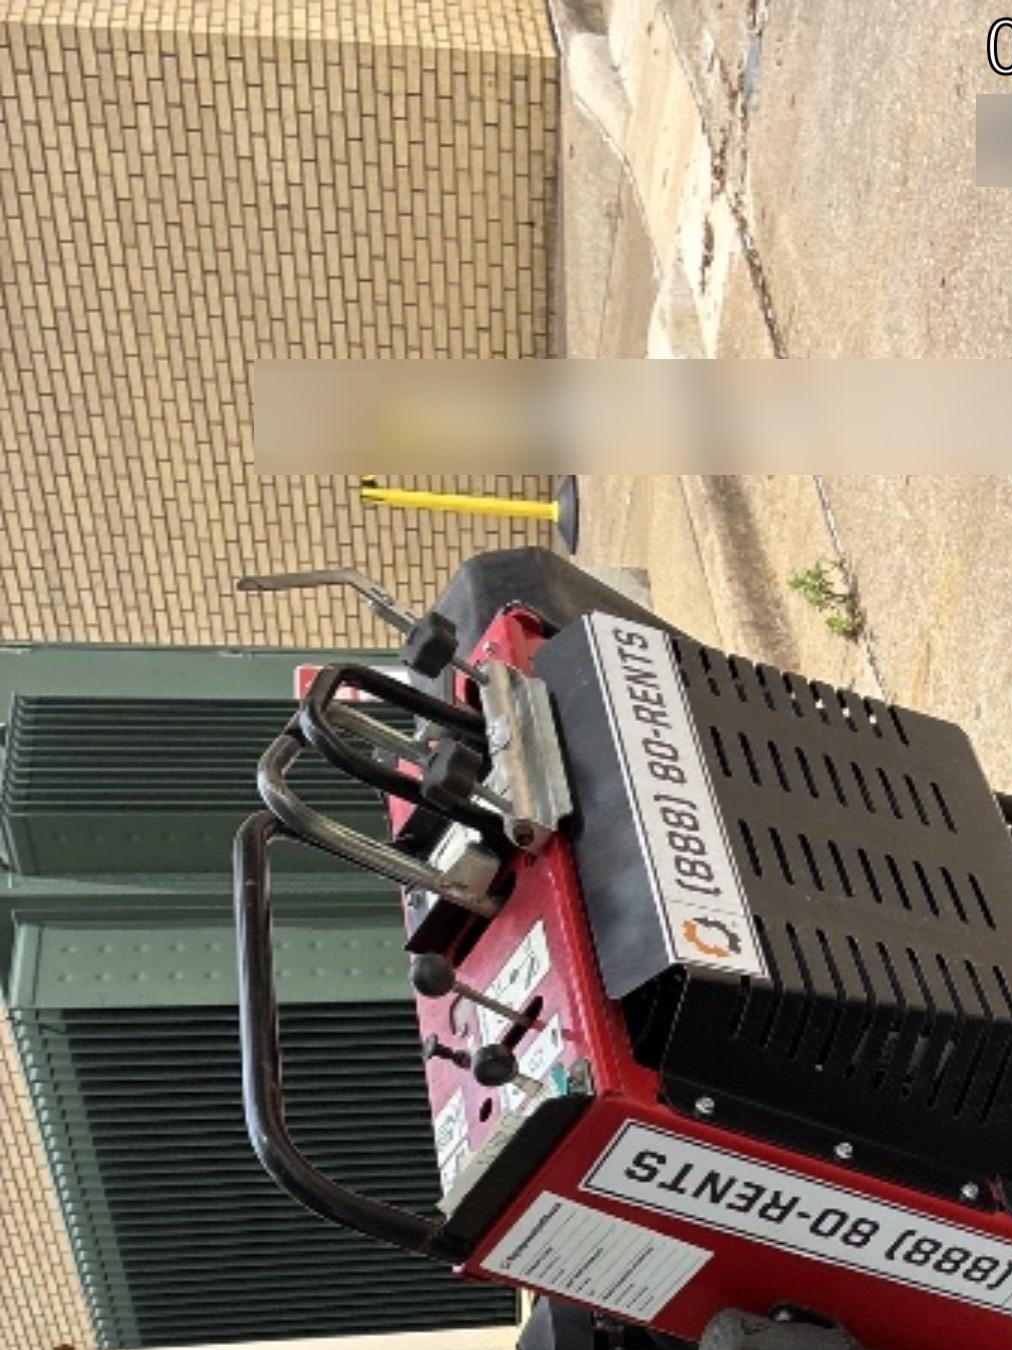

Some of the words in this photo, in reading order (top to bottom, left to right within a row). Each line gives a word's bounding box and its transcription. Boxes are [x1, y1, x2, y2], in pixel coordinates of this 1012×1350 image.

[612, 628, 689, 787] 80-RENTS
[653, 793, 723, 897] (888)
[624, 1149, 880, 1247] 80-RENTS
